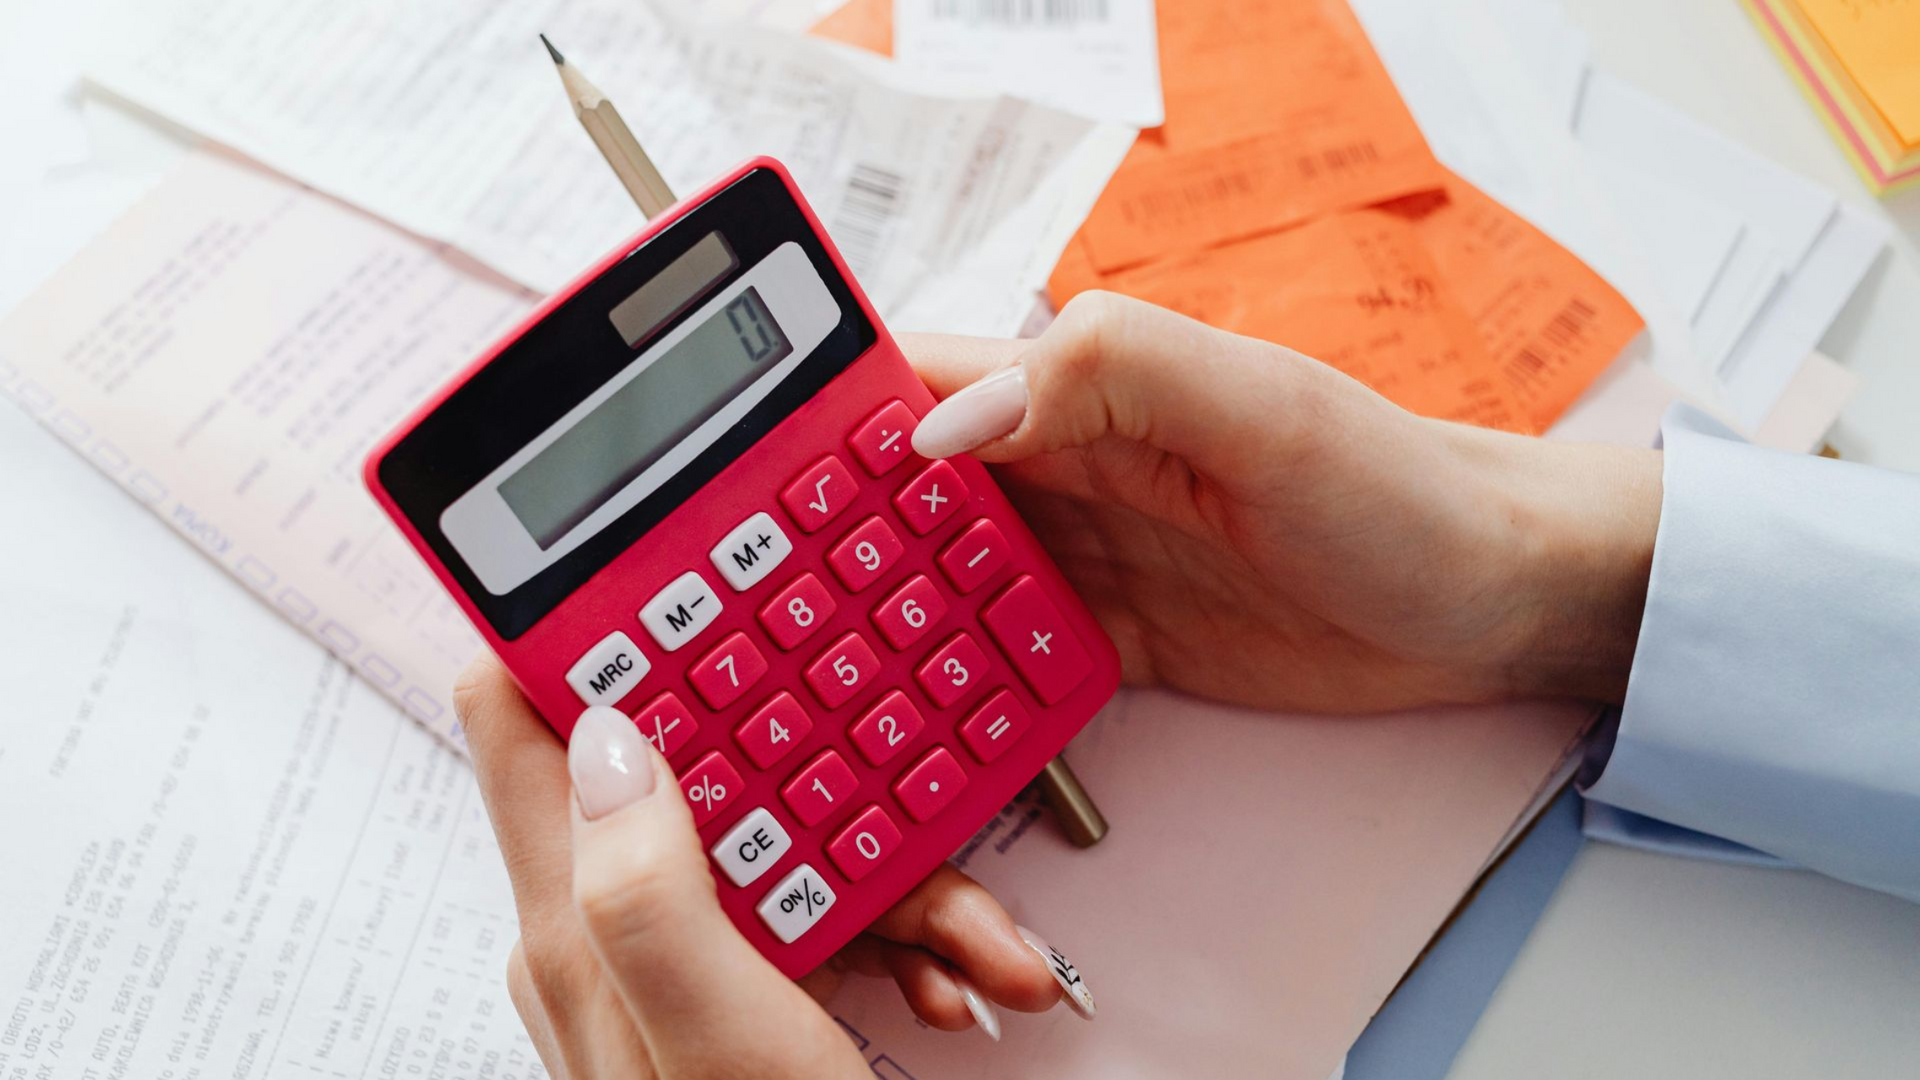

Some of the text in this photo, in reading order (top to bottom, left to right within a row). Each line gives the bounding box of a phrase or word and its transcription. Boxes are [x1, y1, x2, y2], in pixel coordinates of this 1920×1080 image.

[732, 534, 772, 572] M+
[855, 541, 881, 571] 9
[787, 597, 814, 627] 8
[901, 599, 926, 628] 6
[589, 653, 634, 695] MRC
[715, 654, 739, 687] 7
[832, 655, 859, 686] 5
[943, 657, 969, 686] 3
[768, 717, 790, 744] 4
[878, 715, 906, 747] 2
[812, 778, 834, 803] 1
[738, 827, 775, 863] CE
[855, 831, 881, 860] 0
[90, 1019, 122, 1063] AUTO,
[109, 970, 140, 1016] BEATA
[129, 942, 152, 970] KOT
[0, 994, 34, 1048] OBROTU
[163, 1027, 191, 1064] dnia
